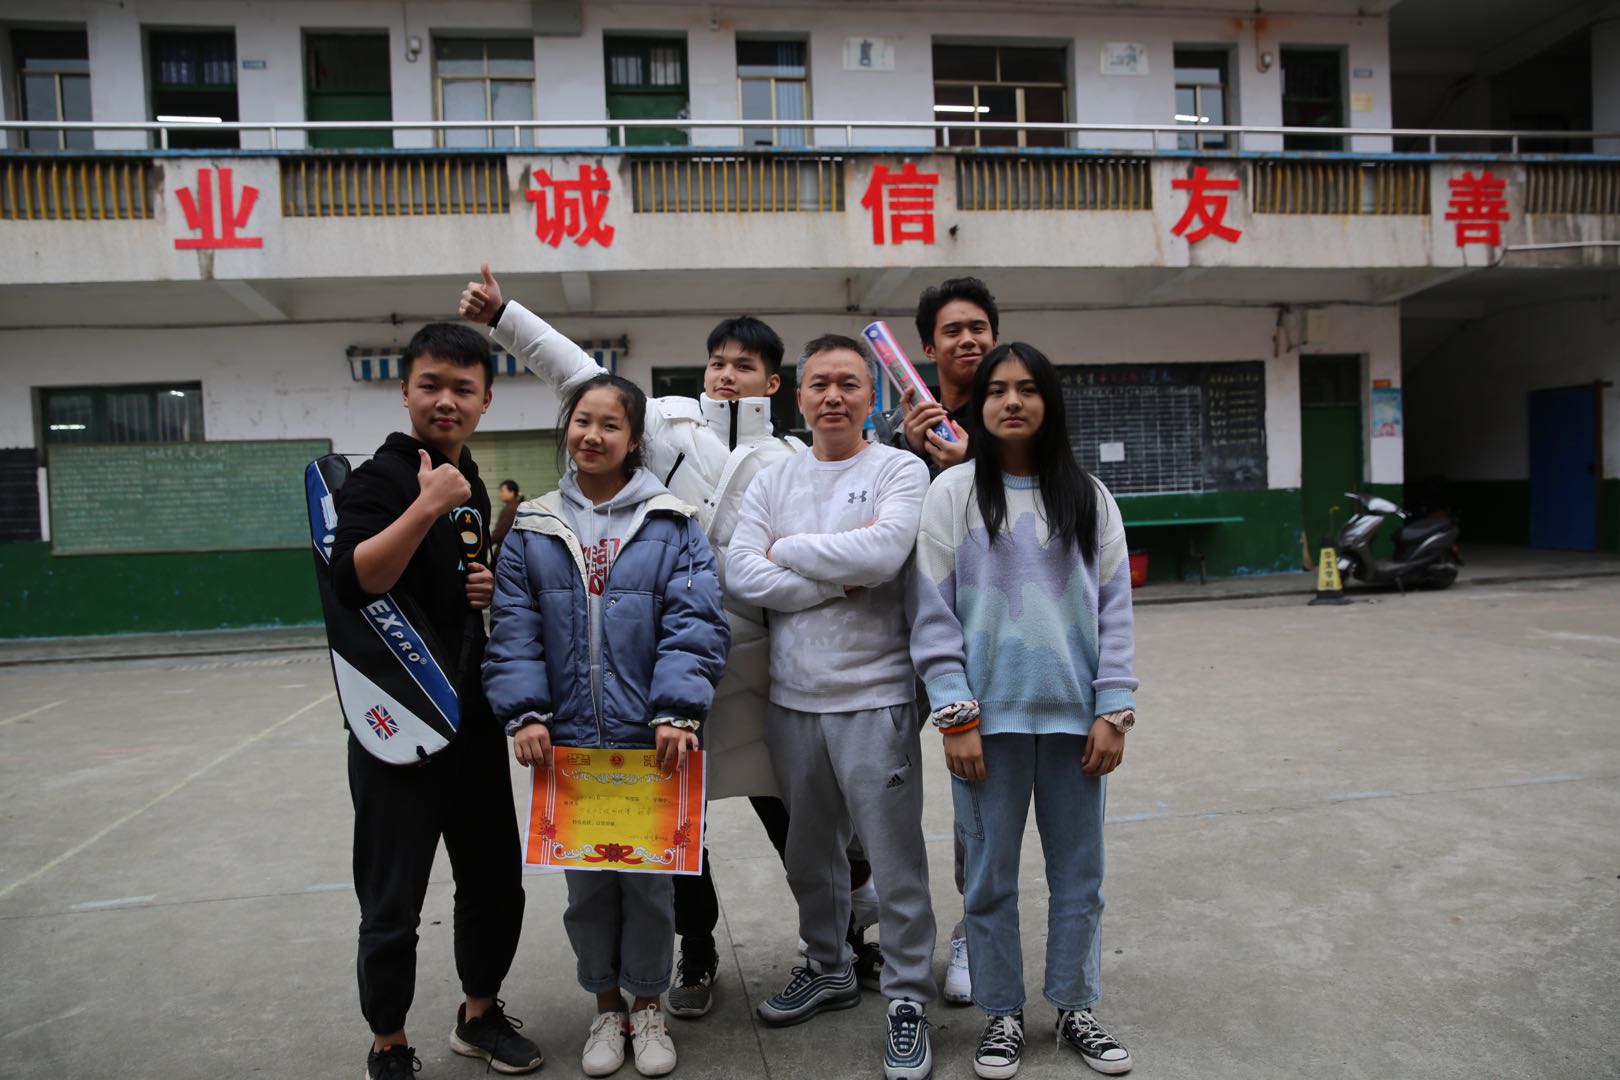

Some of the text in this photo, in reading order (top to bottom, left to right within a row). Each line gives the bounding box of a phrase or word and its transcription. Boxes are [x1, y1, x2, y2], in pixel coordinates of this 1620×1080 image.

[174, 162, 1511, 249] 业 诚 信 友 善
